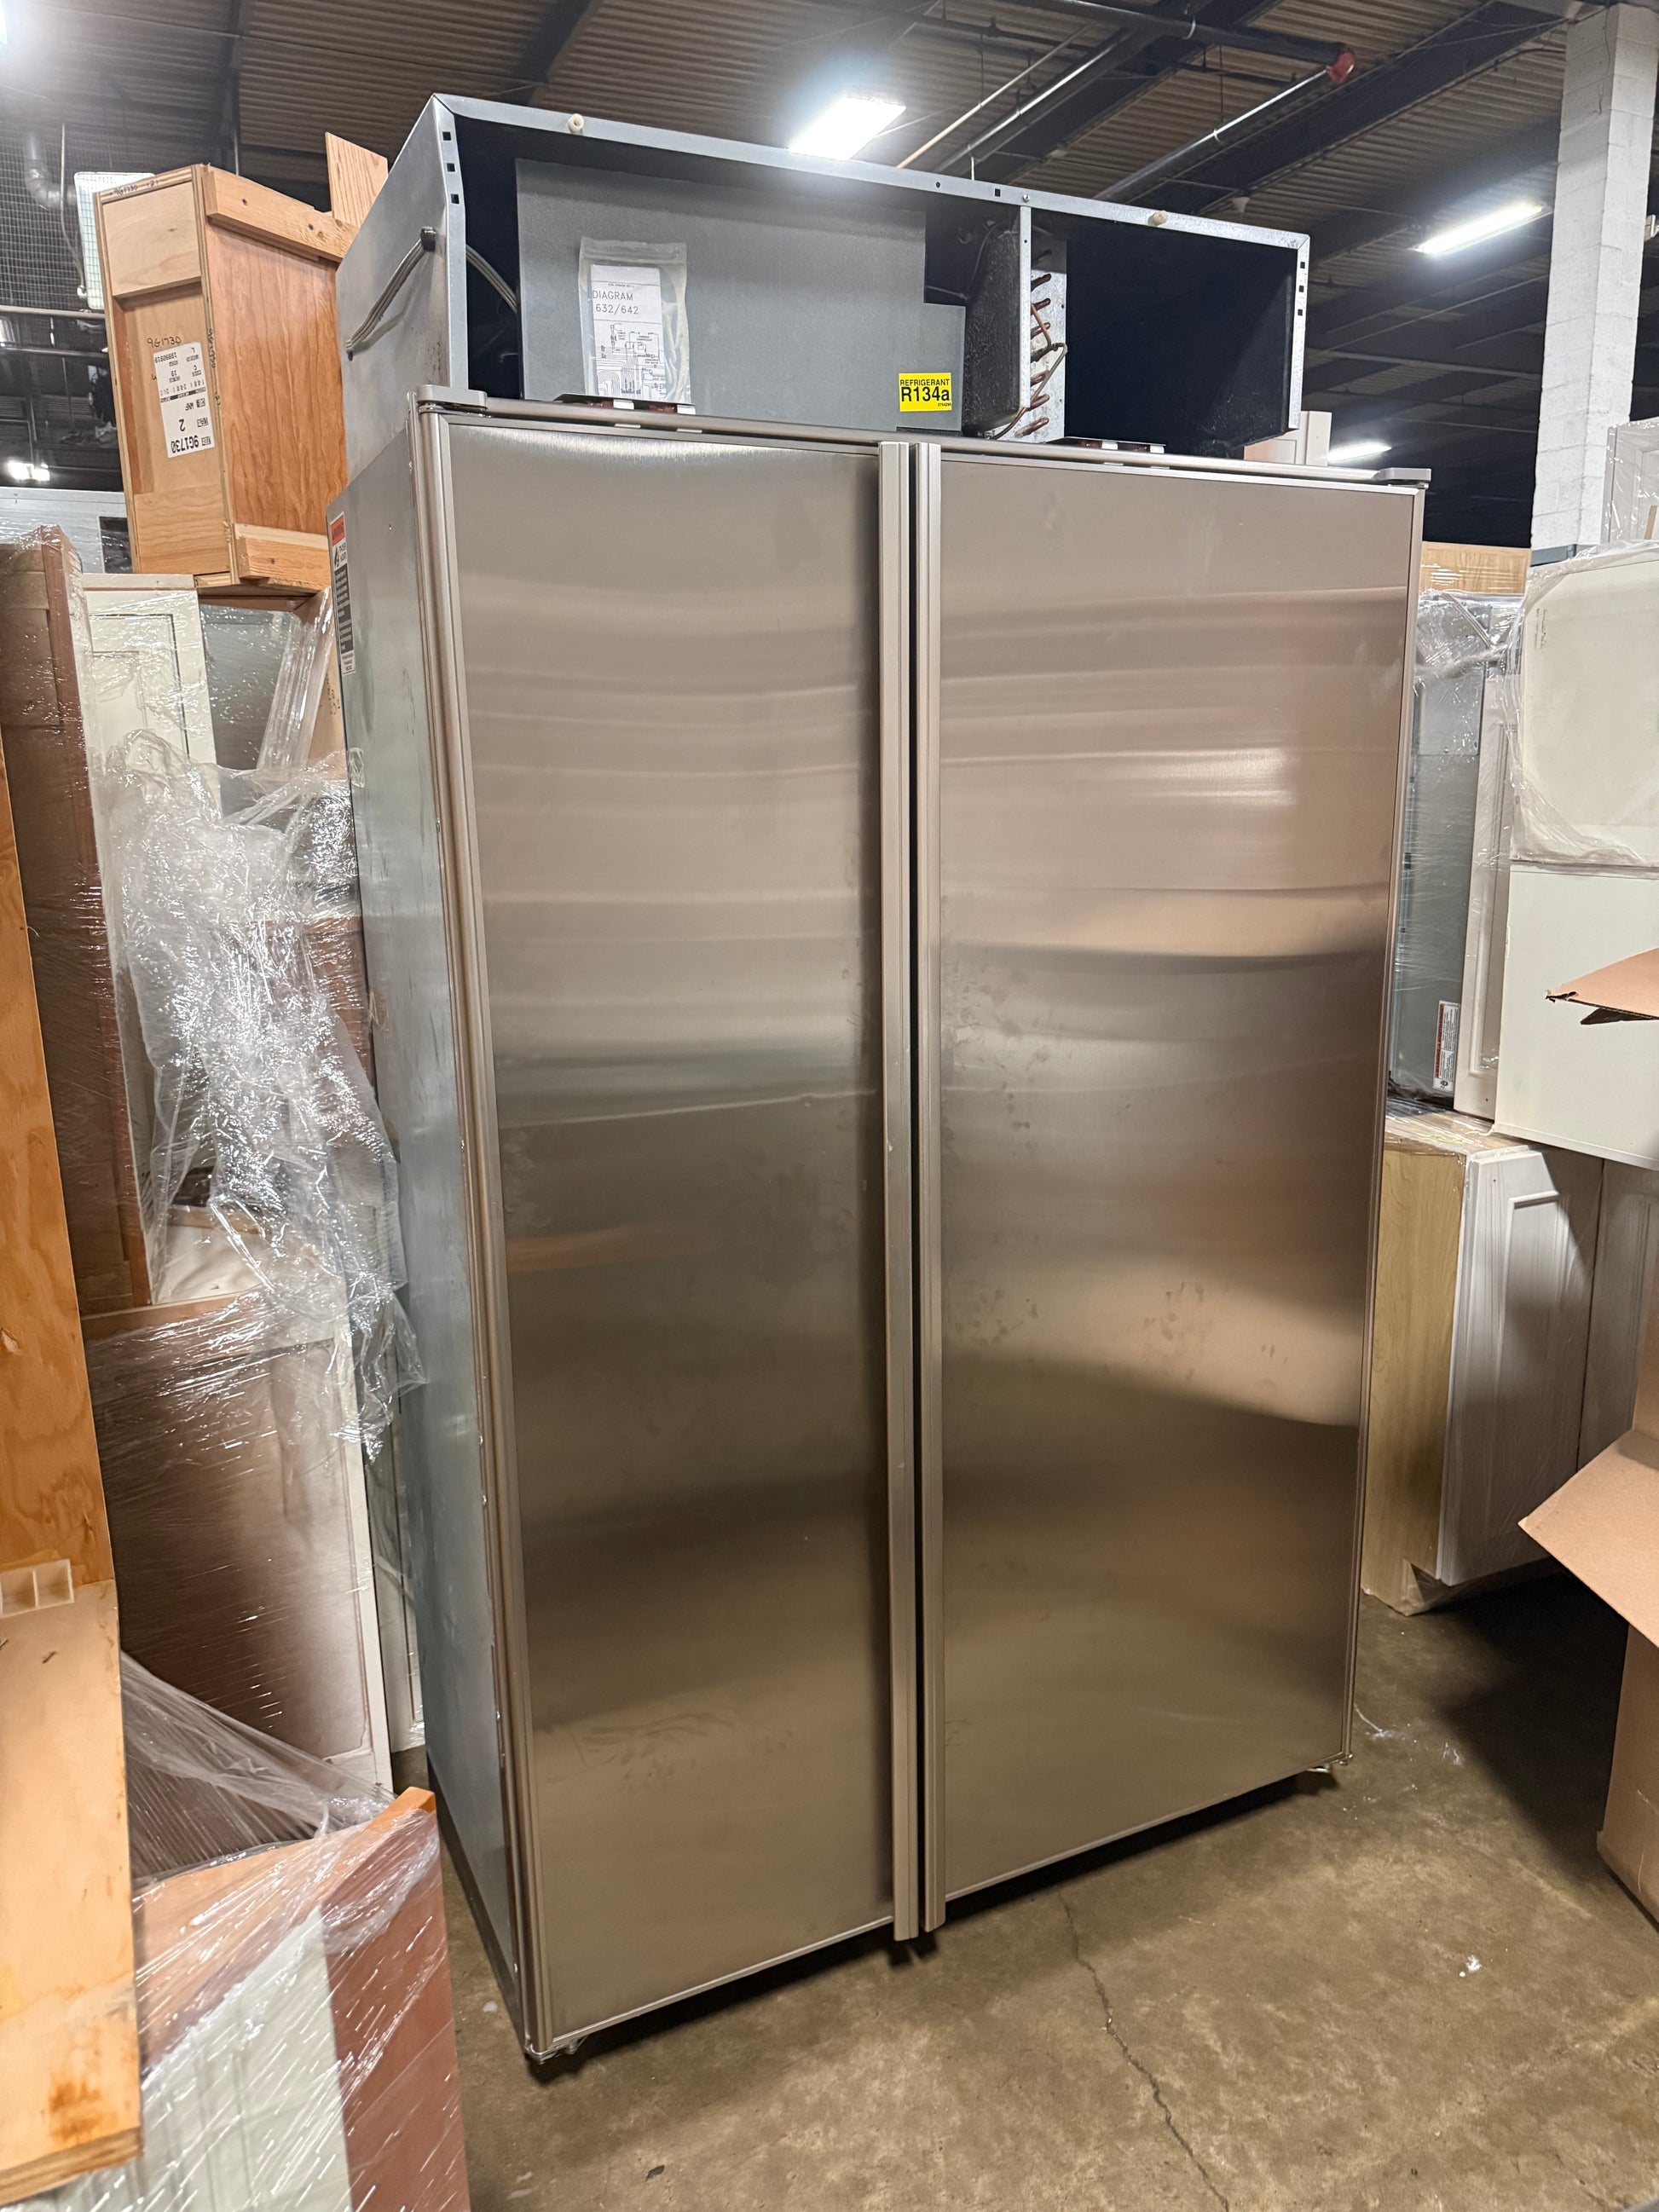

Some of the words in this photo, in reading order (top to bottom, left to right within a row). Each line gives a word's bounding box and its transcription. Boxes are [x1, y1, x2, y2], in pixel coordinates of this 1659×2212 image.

[592, 290, 633, 301] DIAGRAM
[595, 303, 639, 315] 632/642
[901, 386, 950, 401] R134a
[178, 419, 186, 432] 2
[171, 435, 199, 453] 9G1730
